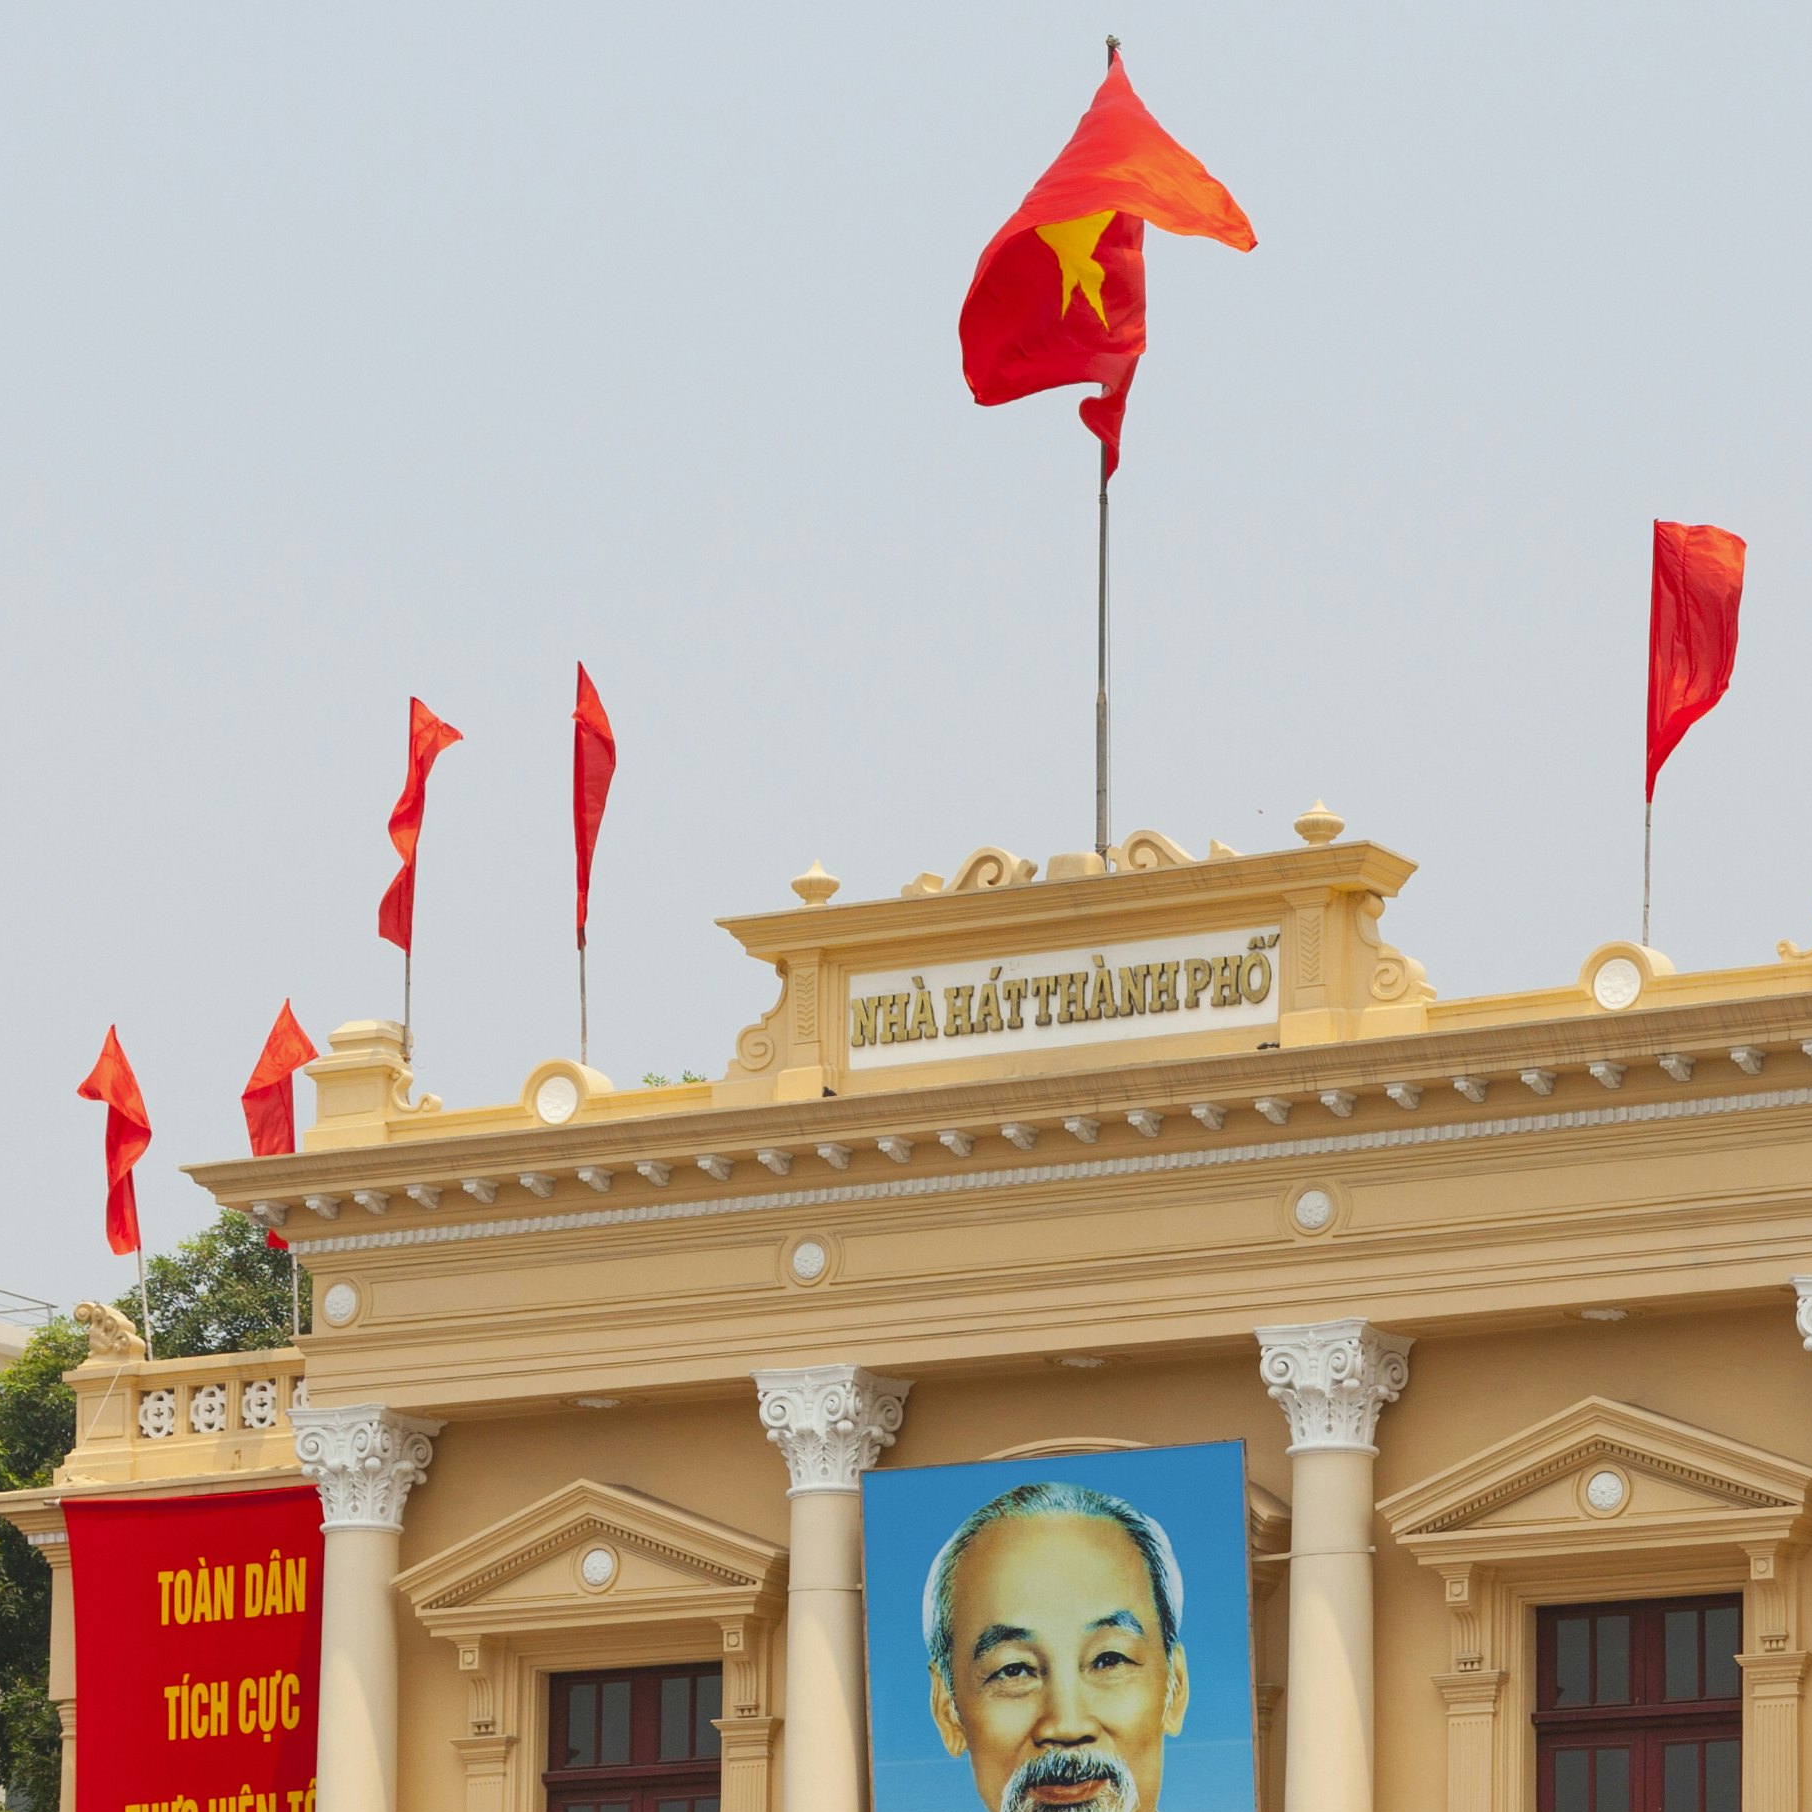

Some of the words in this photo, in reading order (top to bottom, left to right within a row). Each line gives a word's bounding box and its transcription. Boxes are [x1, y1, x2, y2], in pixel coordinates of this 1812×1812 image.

[851, 976, 938, 1047] NHÀ
[943, 966, 1029, 1037] HÁT
[1031, 954, 1180, 1026] THÀNH
[1183, 933, 1281, 1008] PHỐ
[157, 1557, 235, 1626] TOÀN
[244, 1548, 306, 1618] DÂN
[164, 1673, 229, 1741] TÍCH
[238, 1669, 300, 1743] CỰC
